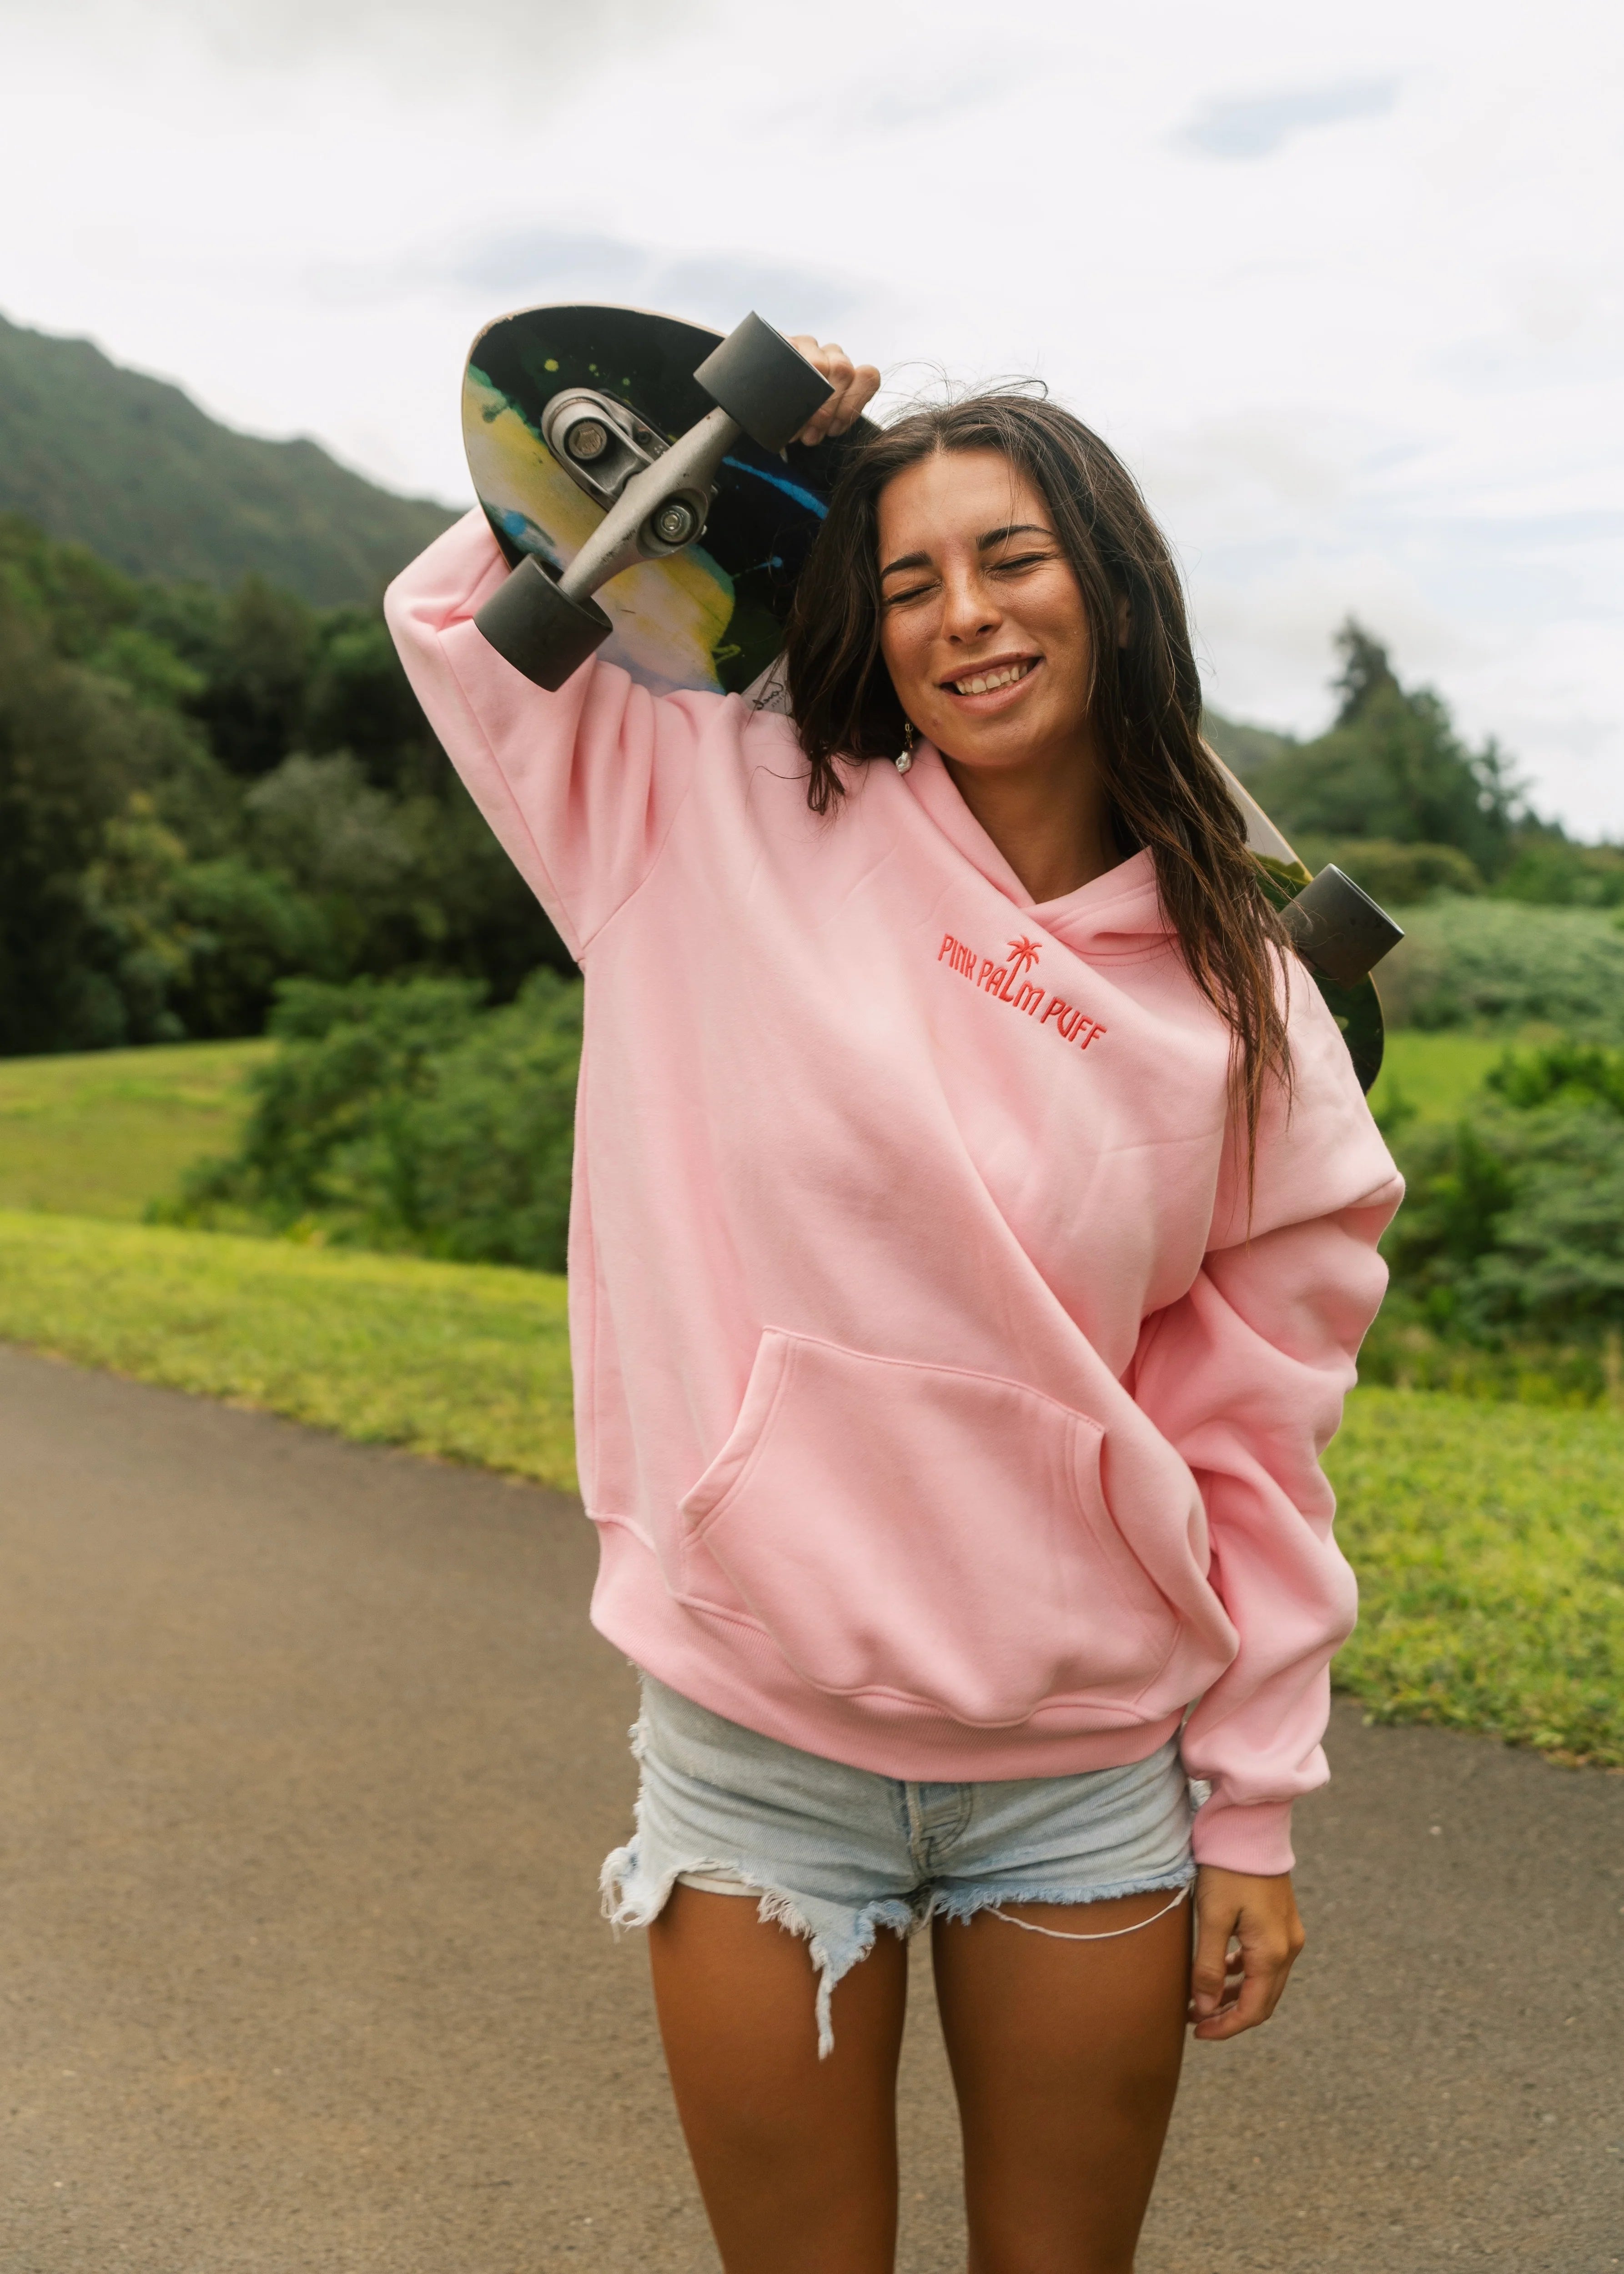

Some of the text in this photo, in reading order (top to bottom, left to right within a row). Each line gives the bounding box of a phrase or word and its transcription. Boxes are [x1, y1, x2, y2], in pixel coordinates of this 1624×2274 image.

[938, 933, 1107, 1050] PINK PALM PUFF
